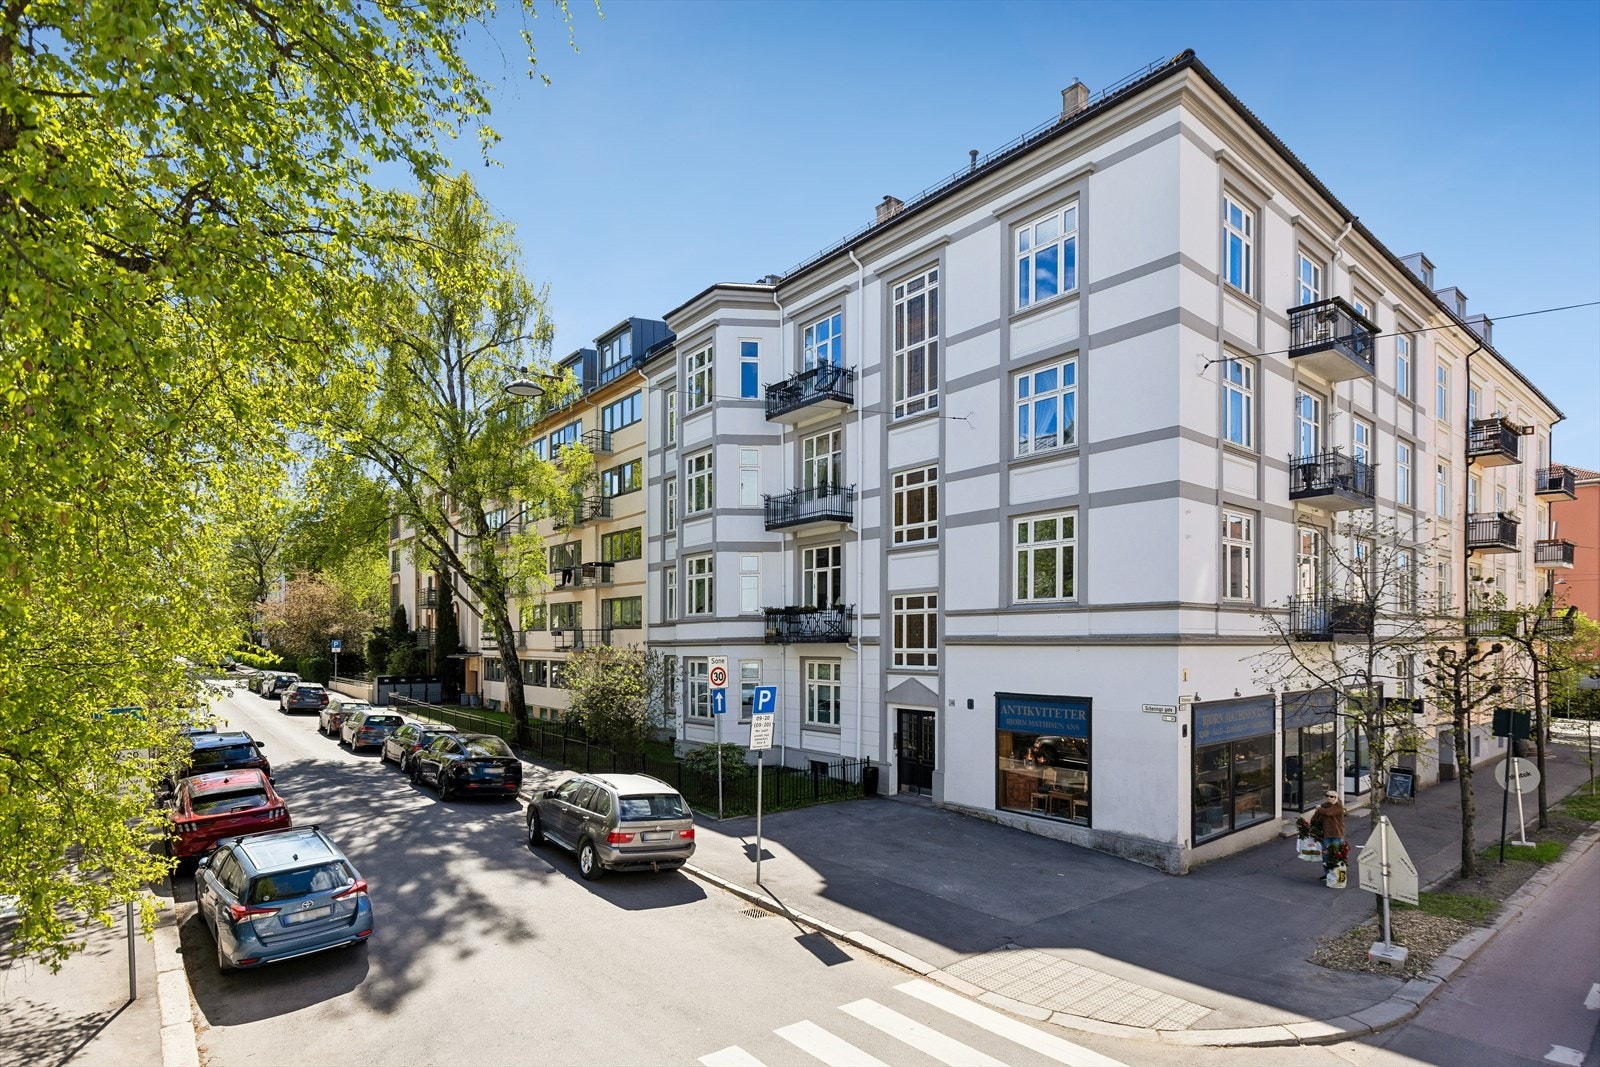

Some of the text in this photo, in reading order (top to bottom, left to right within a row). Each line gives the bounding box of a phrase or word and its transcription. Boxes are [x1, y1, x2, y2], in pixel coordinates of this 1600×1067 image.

[713, 672, 723, 681] 30
[758, 690, 771, 710] P
[1001, 705, 1087, 721] ANTIKVITETER
[1028, 720, 1064, 730] MATHISEN
